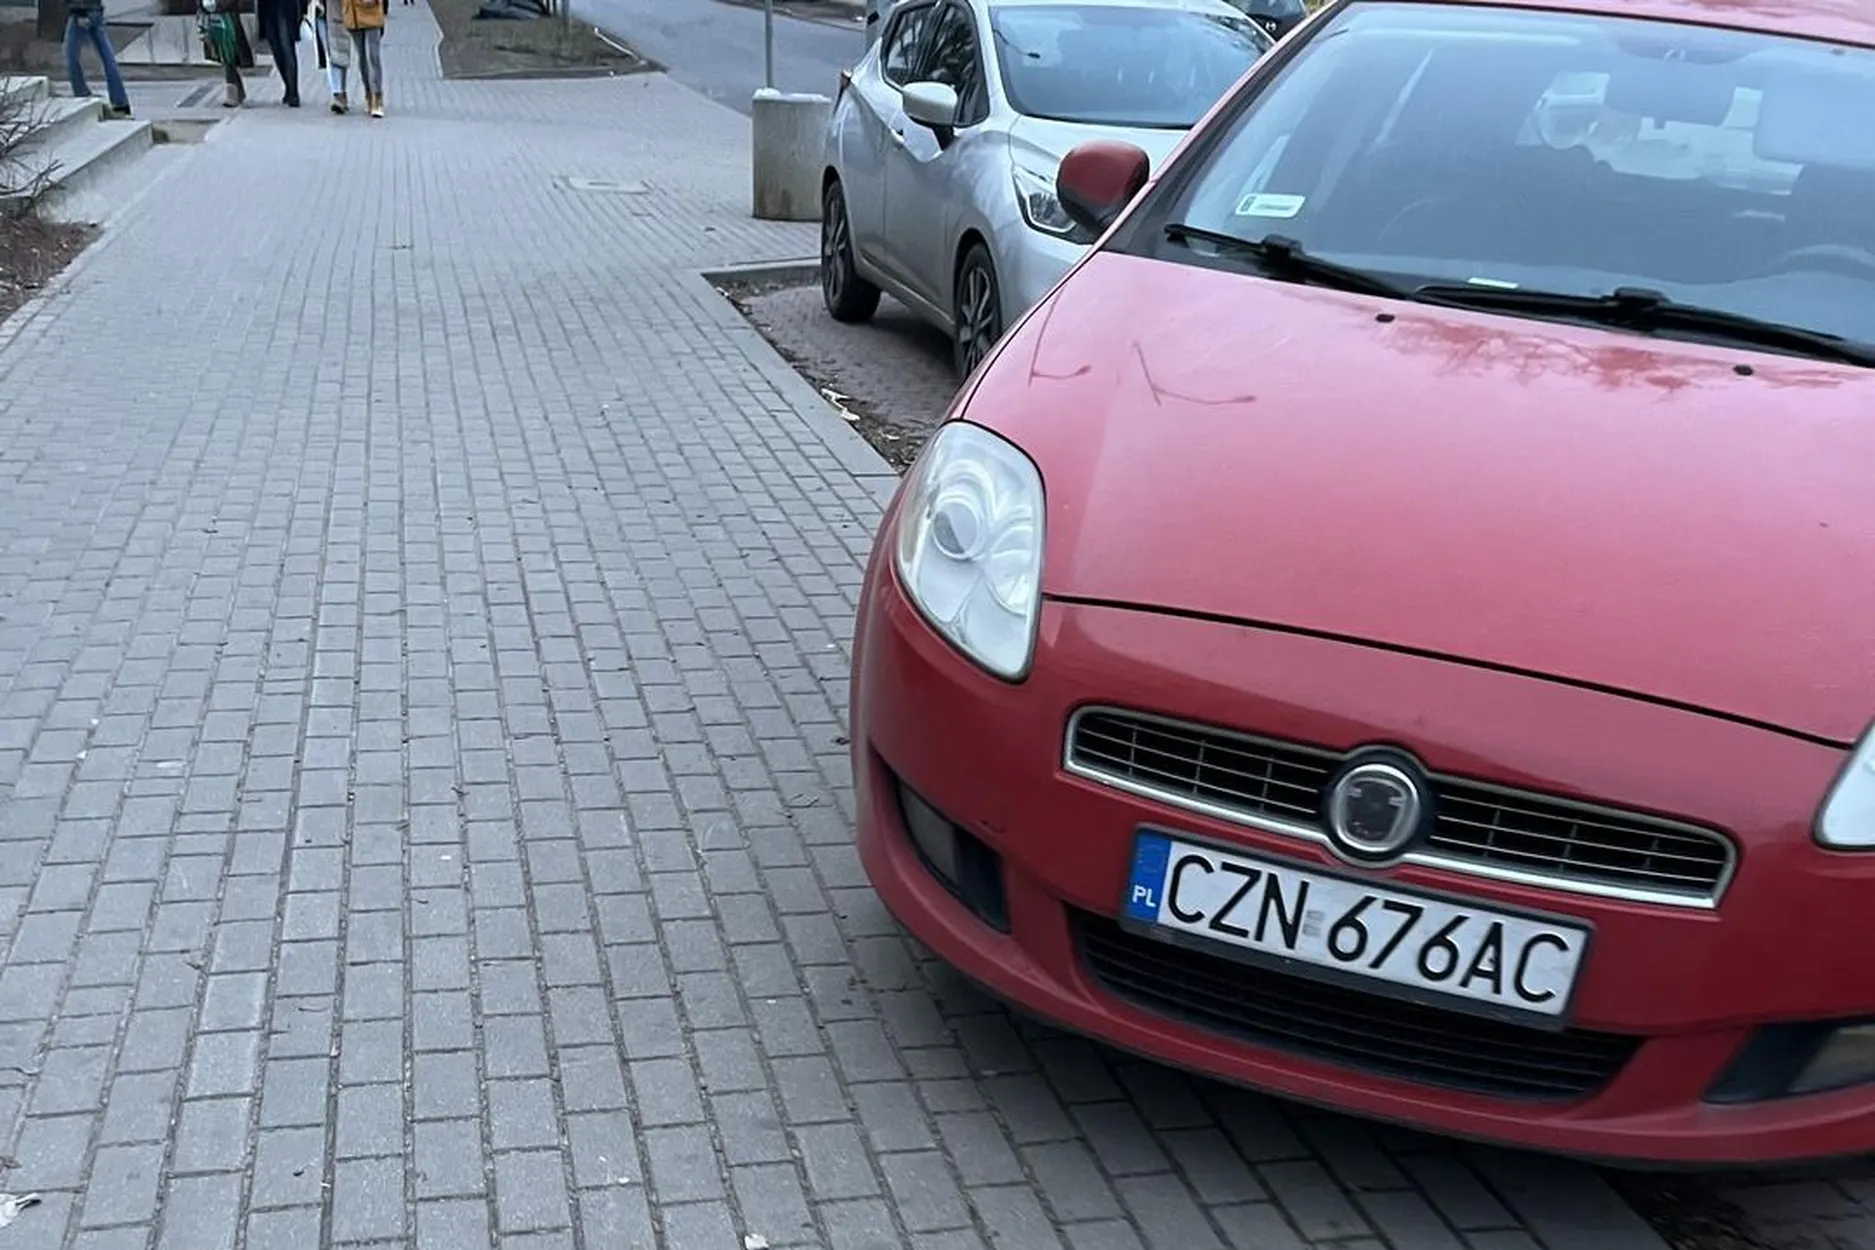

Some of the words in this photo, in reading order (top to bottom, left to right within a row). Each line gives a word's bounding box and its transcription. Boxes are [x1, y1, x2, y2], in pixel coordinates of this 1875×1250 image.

[1132, 886, 1157, 909] PL
[1168, 855, 1310, 950] CZN
[1327, 896, 1570, 1003] 676AC
